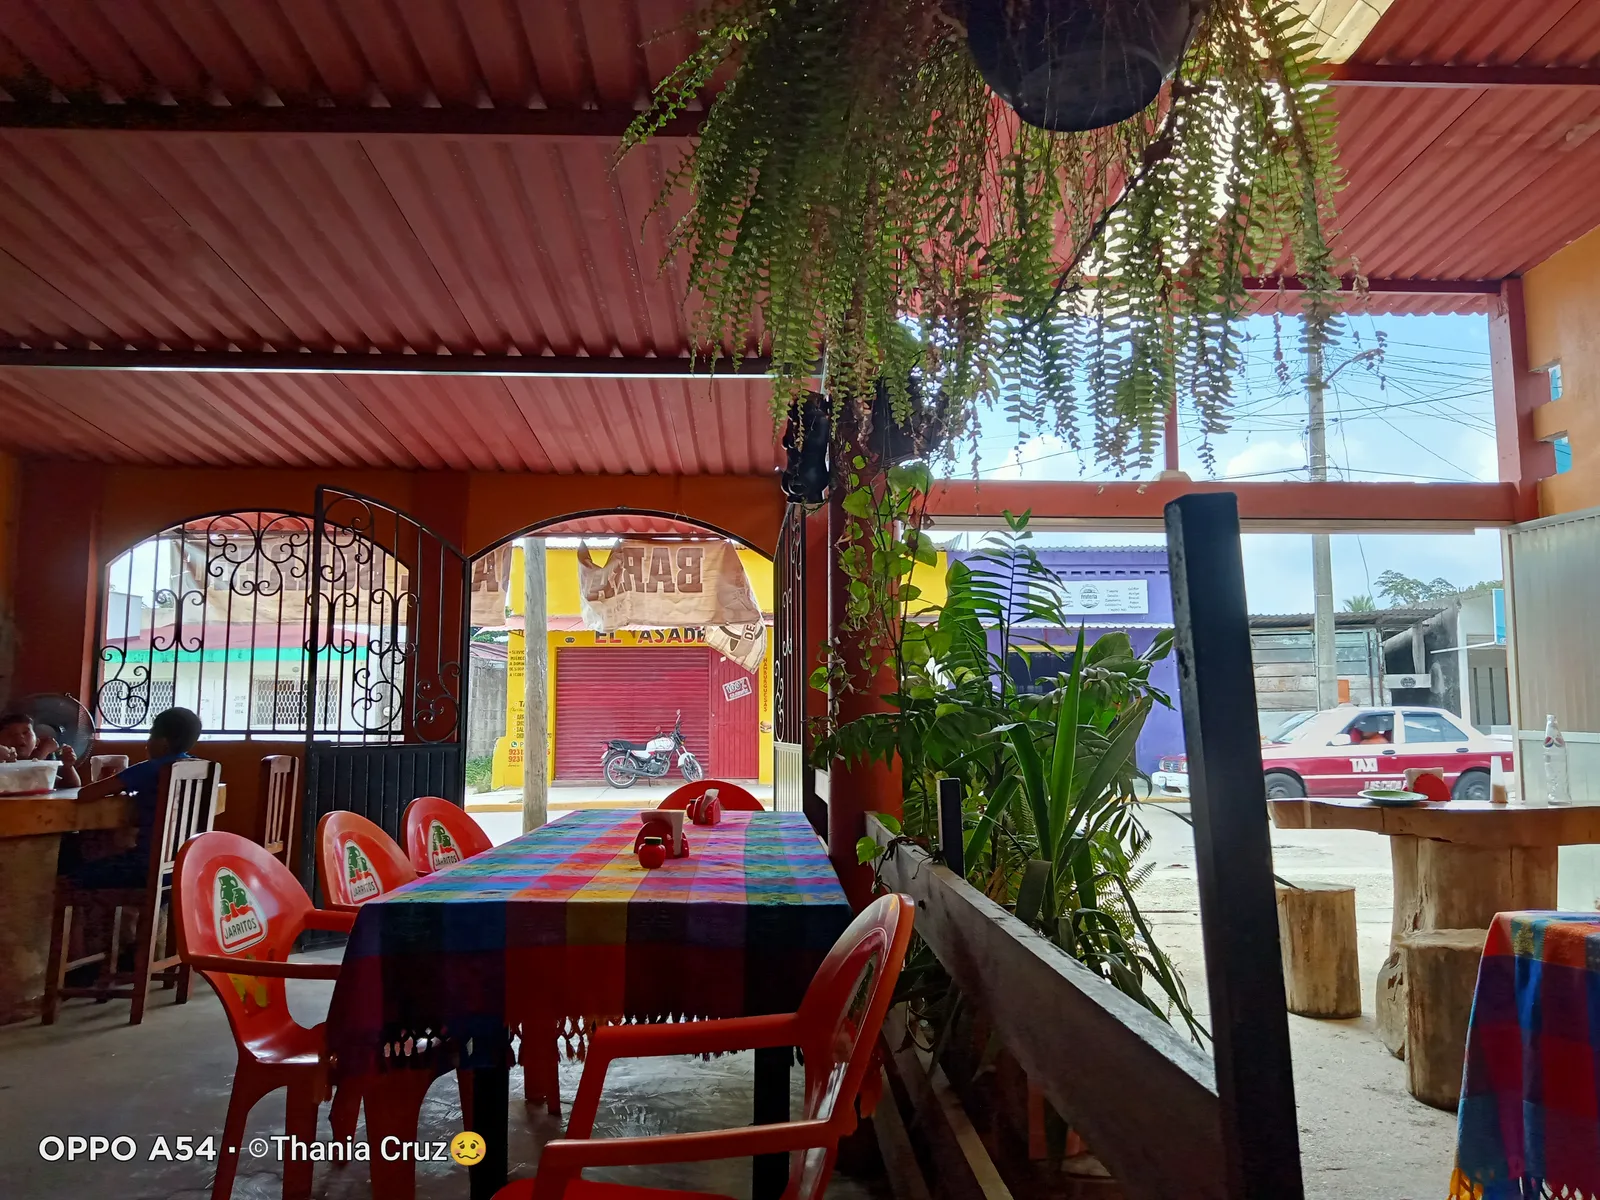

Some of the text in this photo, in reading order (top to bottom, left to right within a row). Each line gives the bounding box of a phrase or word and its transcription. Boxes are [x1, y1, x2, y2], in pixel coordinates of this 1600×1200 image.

[637, 627, 706, 645] ASADE
[1349, 758, 1378, 773] TAXI
[436, 855, 458, 867] JARRITOS
[353, 881, 376, 897] JARRITOS
[225, 918, 257, 940] JARRITOS
